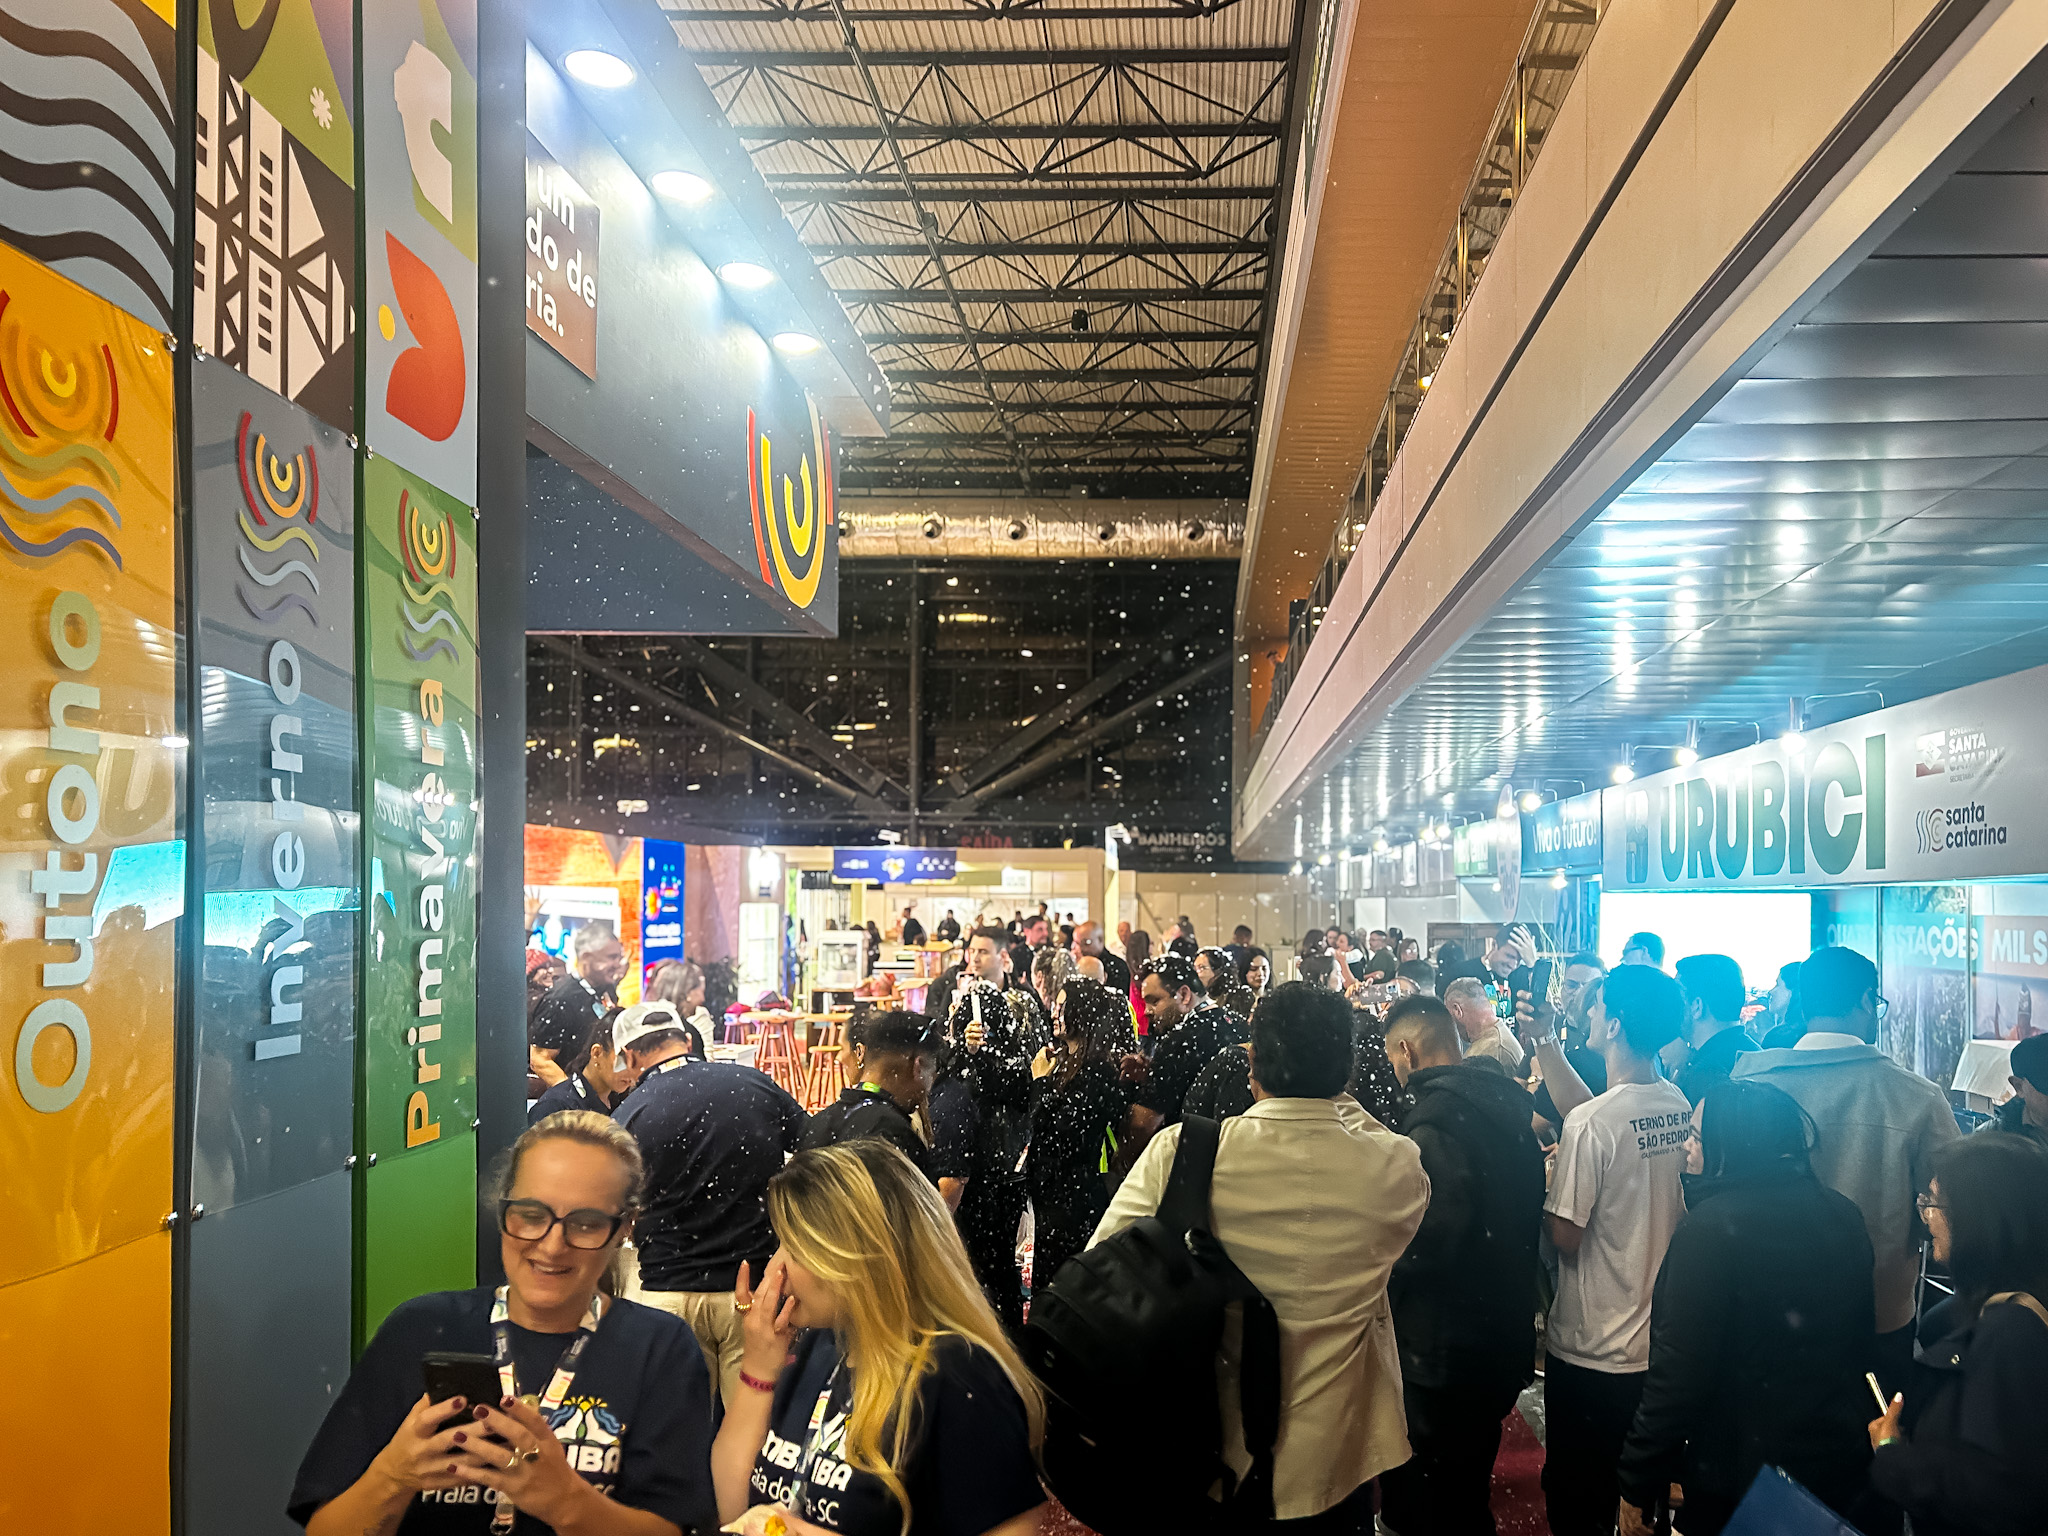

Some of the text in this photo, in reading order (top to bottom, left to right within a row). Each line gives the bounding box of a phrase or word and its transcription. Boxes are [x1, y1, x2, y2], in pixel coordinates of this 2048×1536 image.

[566, 248, 597, 310] de
[1948, 732, 1987, 755] SANTA
[1660, 733, 1886, 883] URUBICI
[1945, 801, 1985, 826] santa
[15, 590, 101, 1114] Outono
[254, 638, 306, 1062] Inverno
[1138, 831, 1227, 847] BANHEIROS
[1532, 815, 1598, 855] Viva o futuro!
[1945, 823, 2007, 849] catarina
[405, 677, 445, 1149] Primavera
[1887, 917, 1979, 966] ESTAÇÕES
[1991, 928, 2031, 964] MIL
[1629, 1115, 1665, 1133] TERNO
[1666, 1113, 1680, 1127] DE
[1637, 1129, 1689, 1150] SÃO PEDRO
